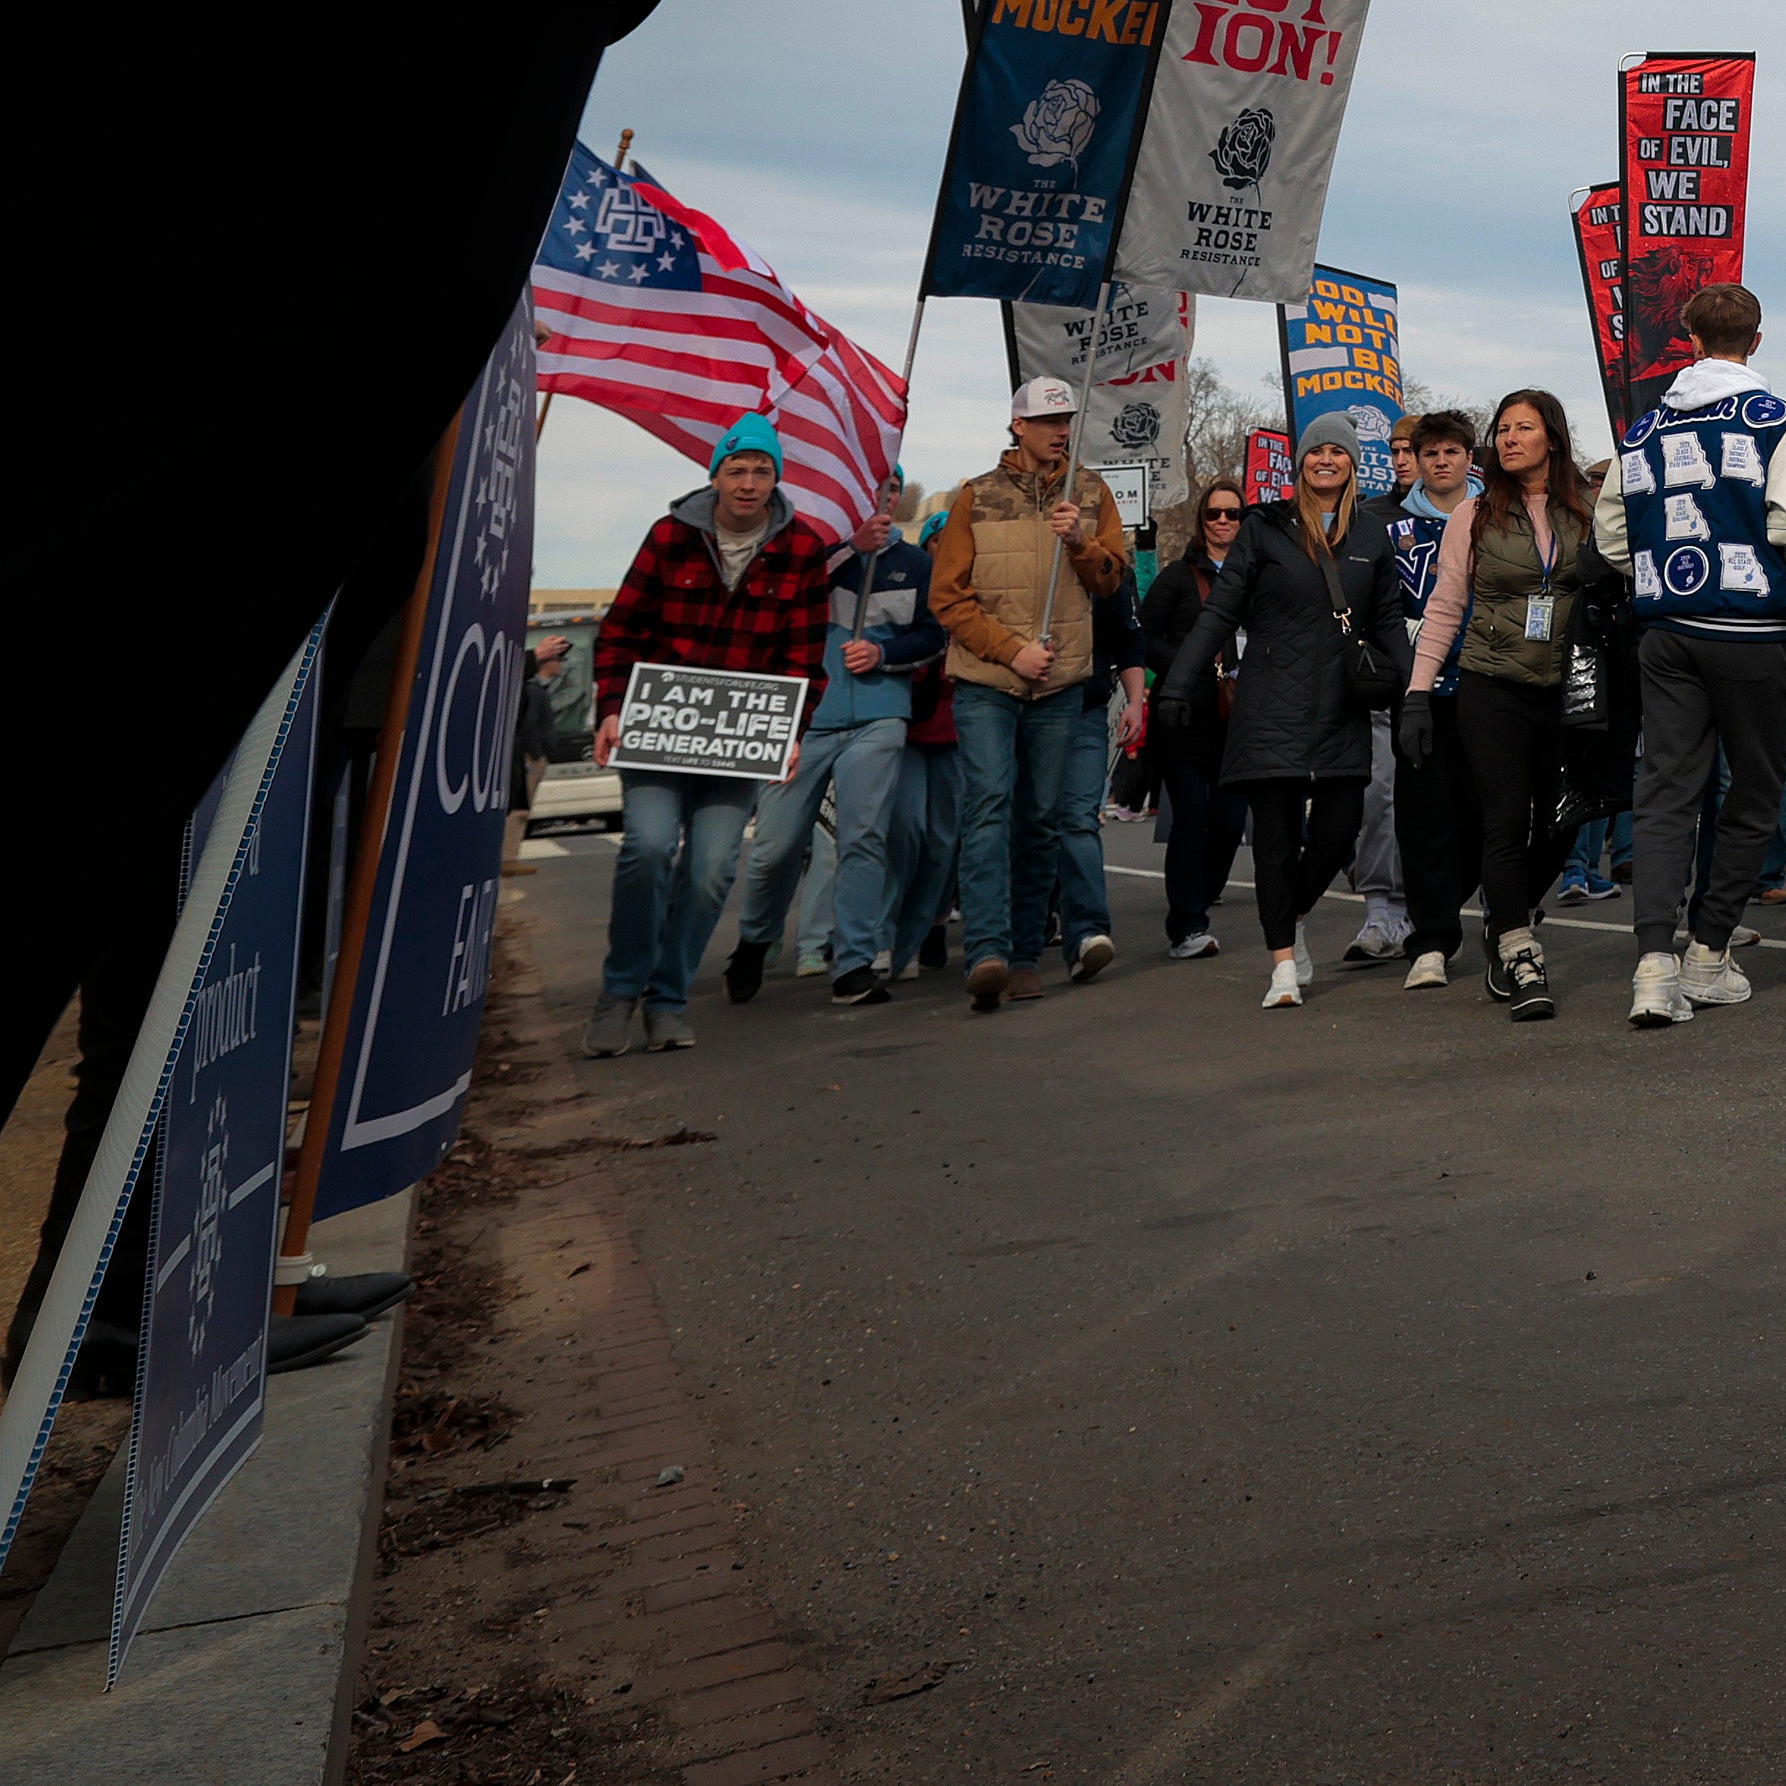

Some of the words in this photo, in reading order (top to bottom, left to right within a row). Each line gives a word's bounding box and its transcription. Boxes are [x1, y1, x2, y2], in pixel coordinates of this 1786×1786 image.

[1181, 1, 1343, 86] ION!
[1641, 74, 1660, 93] IN
[1666, 74, 1701, 94] THE
[1665, 99, 1736, 131] FACE
[1640, 139, 1661, 159] OF
[1670, 136, 1731, 168] EVIL,
[1033, 179, 1056, 189] THE
[1648, 171, 1697, 200] WE
[968, 181, 1107, 224] WHITE
[1187, 200, 1273, 231] WHITE
[1591, 208, 1608, 226] IN
[975, 214, 1080, 250] ROSE
[1644, 206, 1727, 237] STAND
[1194, 227, 1258, 252] ROSE
[962, 243, 1086, 270] RESISTANCE
[1181, 248, 1261, 267] RESISTANCE
[1601, 261, 1618, 279] OF
[1310, 279, 1365, 307] OD
[1305, 323, 1387, 350] NOT
[1352, 347, 1400, 384] BE
[640, 682, 652, 700] I
[662, 685, 715, 706] AM
[728, 690, 788, 713] THE
[624, 702, 793, 740] PRO-LIFE
[622, 730, 783, 763] GENERATION
[189, 942, 263, 1106] product
